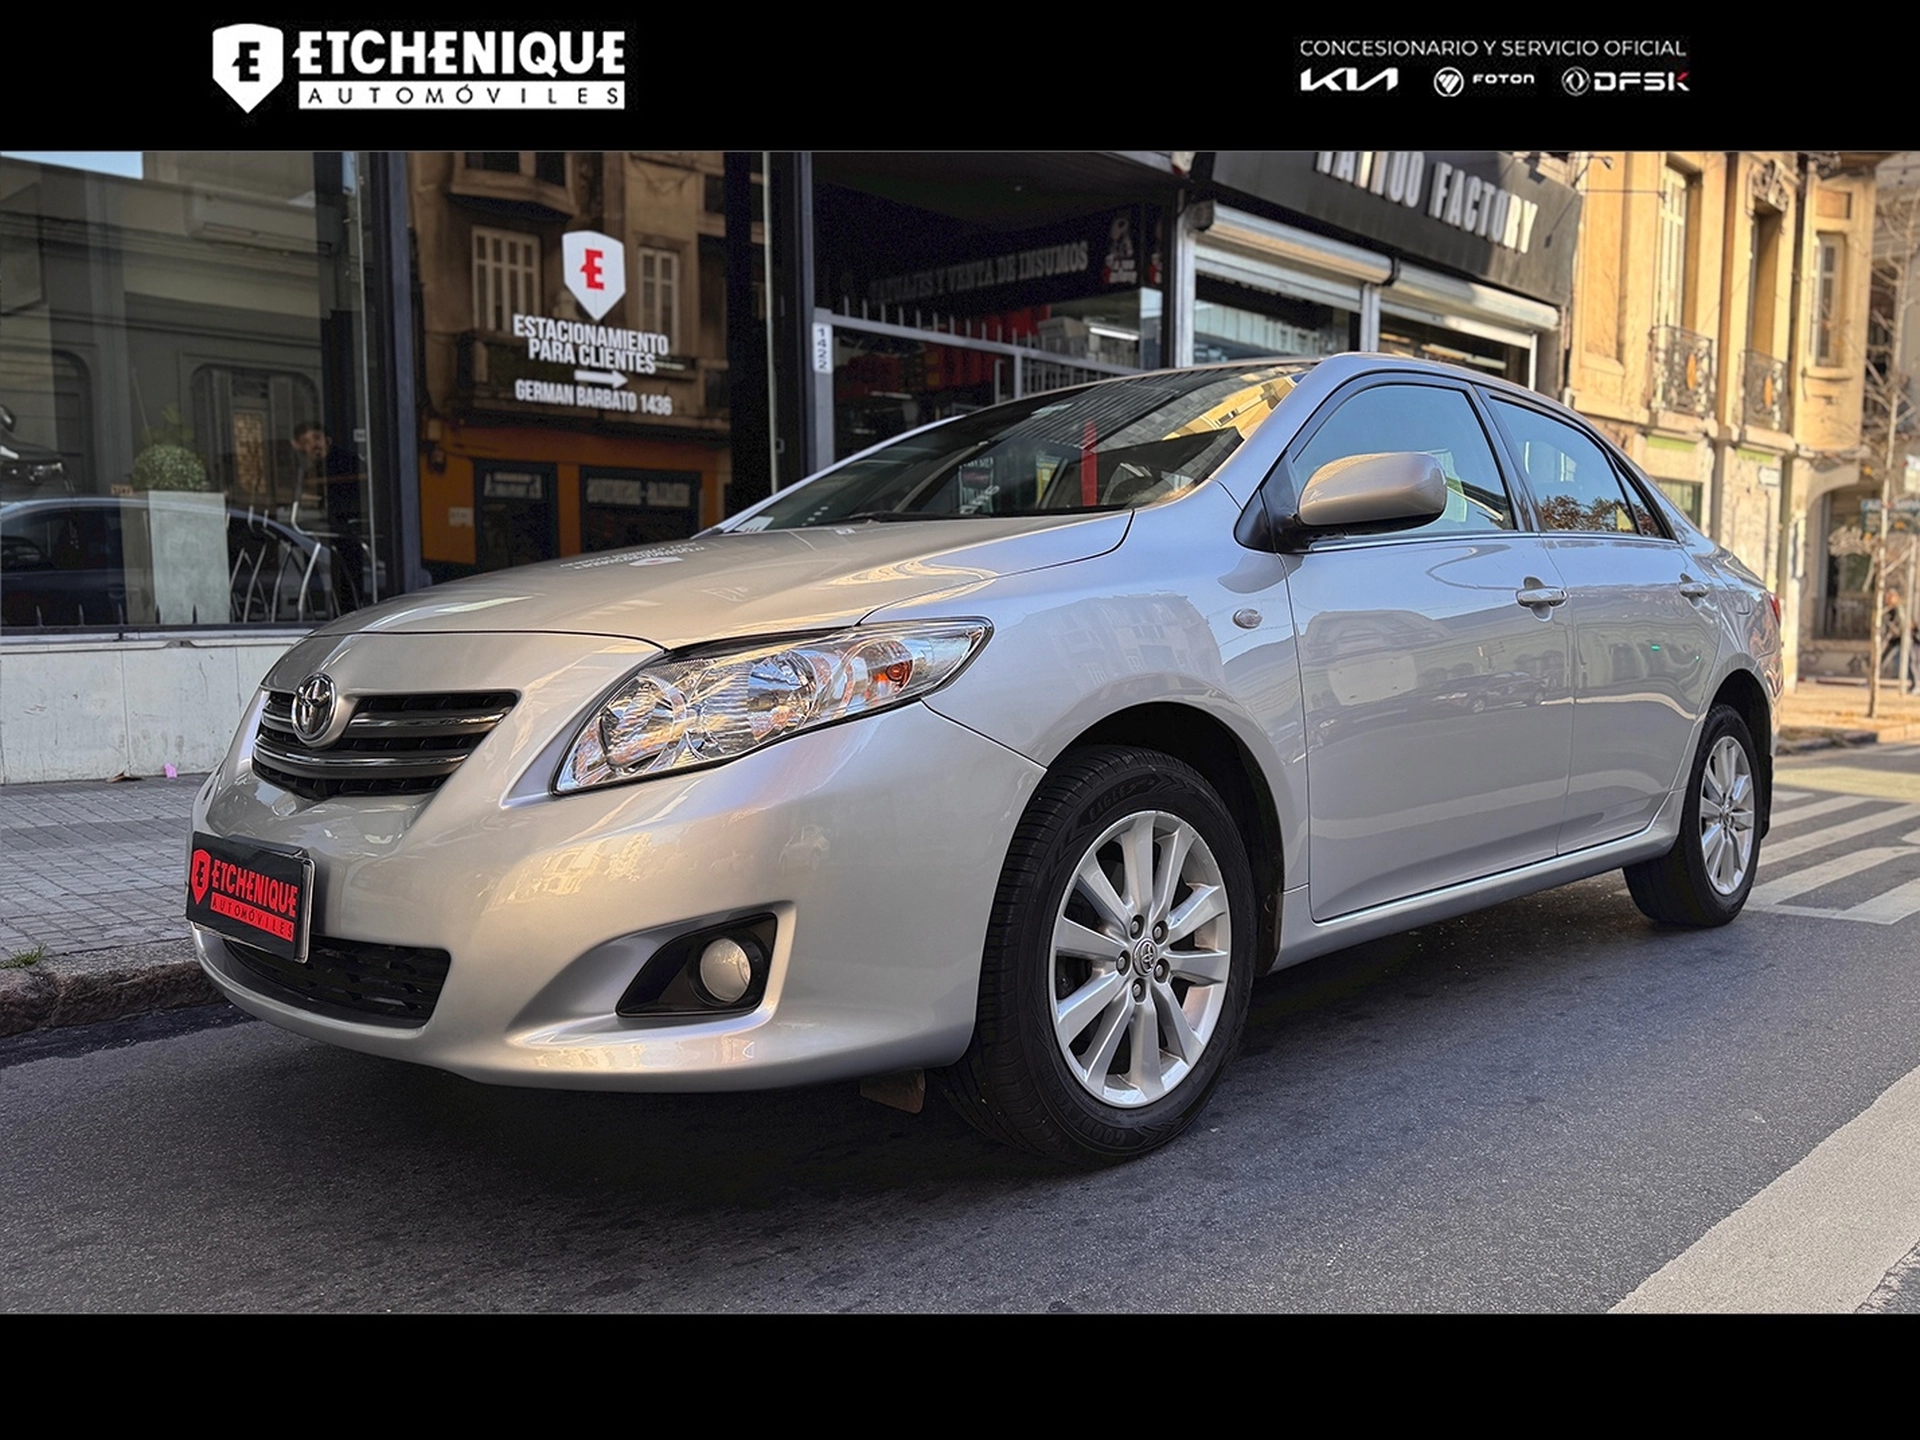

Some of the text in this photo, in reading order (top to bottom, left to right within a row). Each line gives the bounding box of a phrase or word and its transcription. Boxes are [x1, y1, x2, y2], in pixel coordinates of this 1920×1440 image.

[1428, 160, 1538, 254] FACTORY
[1018, 240, 1089, 279] INSUMOS
[513, 313, 669, 356] ESTACIONAMIENTO
[528, 337, 657, 375] PARA CLIENTES
[515, 378, 575, 406] GERMAN
[576, 386, 638, 413] BARBATO
[211, 859, 298, 917] ETCHENIQUE
